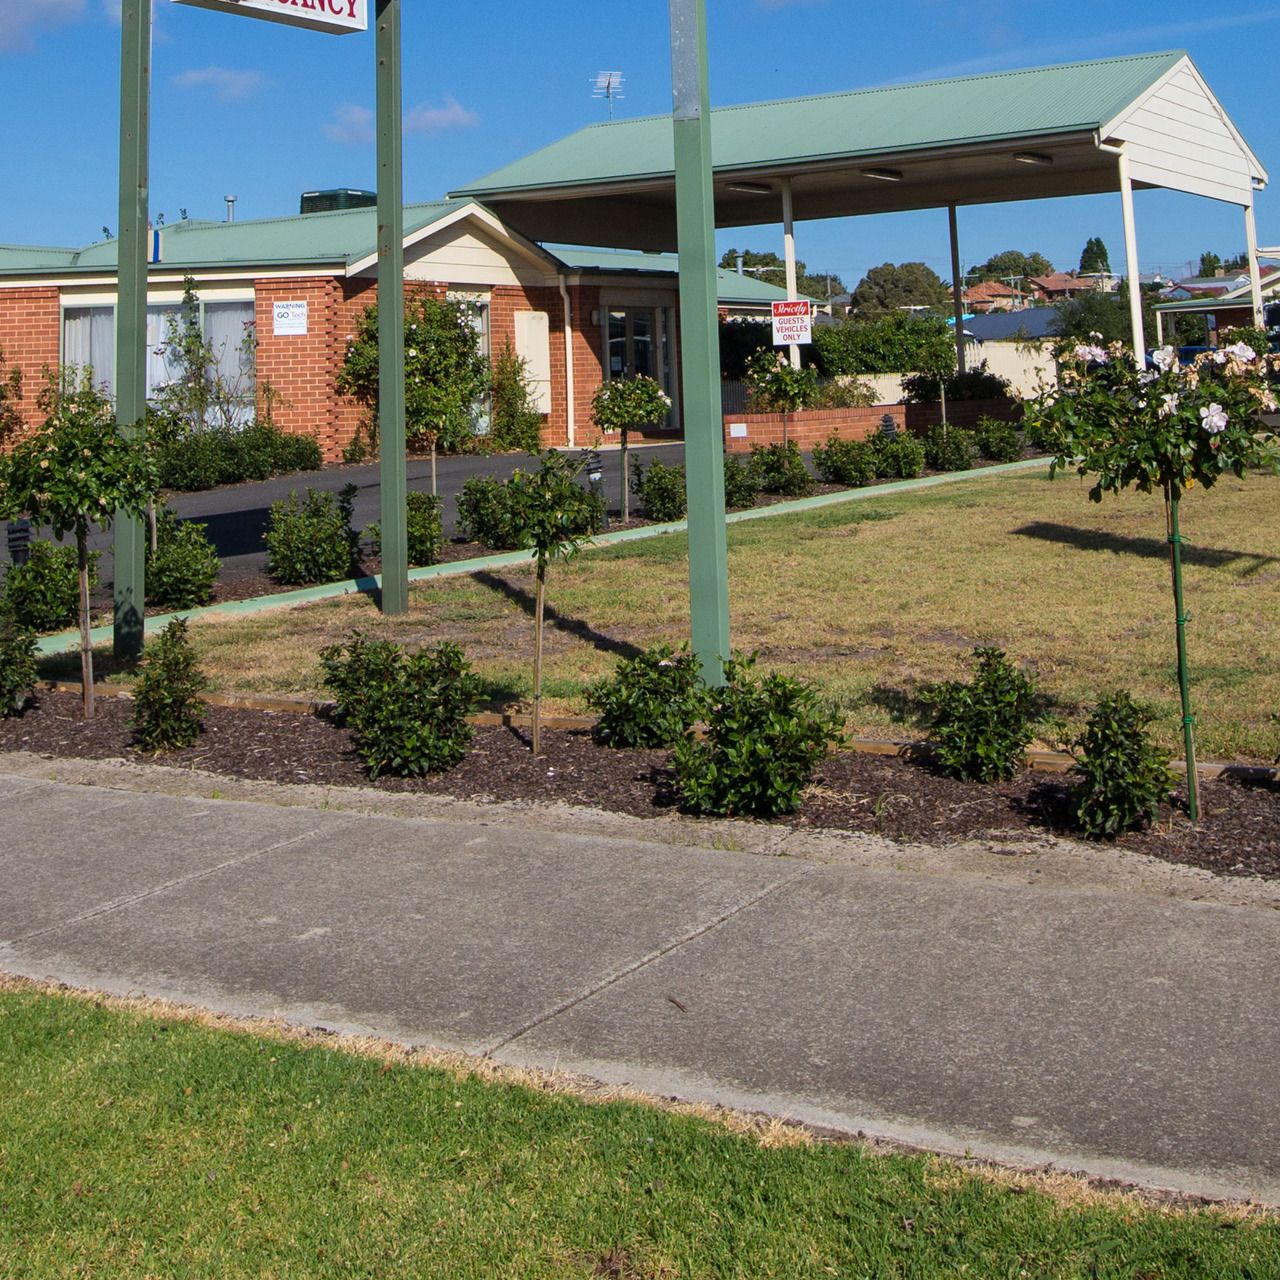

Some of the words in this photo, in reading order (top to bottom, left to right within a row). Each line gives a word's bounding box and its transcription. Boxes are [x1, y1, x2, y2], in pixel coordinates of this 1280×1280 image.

[775, 303, 807, 315] Strictly
[778, 317, 805, 325] GUESTS
[776, 325, 808, 333] VEHICLES
[783, 333, 801, 341] ONLY
